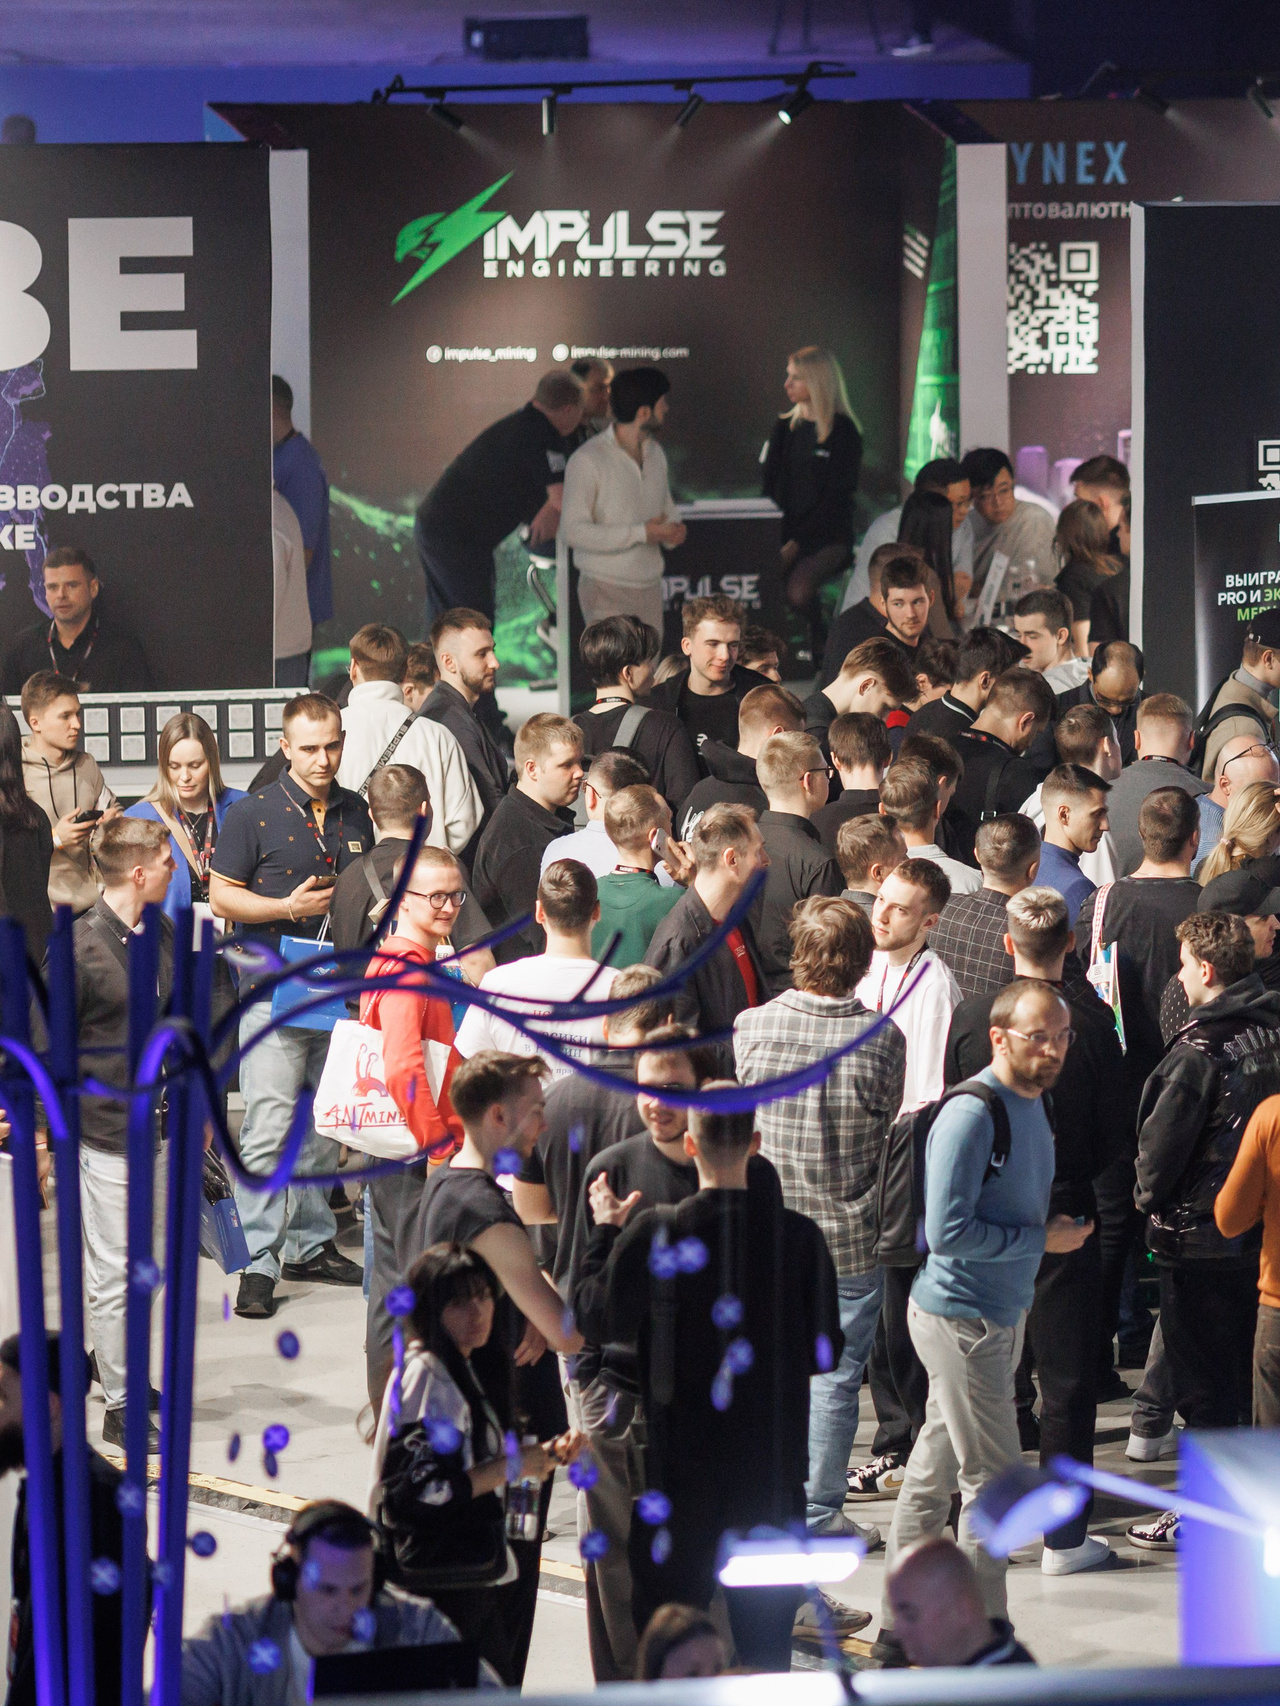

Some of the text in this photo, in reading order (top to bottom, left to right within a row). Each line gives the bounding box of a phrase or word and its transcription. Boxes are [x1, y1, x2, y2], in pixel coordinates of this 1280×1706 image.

[483, 210, 726, 260] IMPULSE
[483, 259, 727, 279] ENGINEERING
[444, 345, 537, 363] impulse_mining
[1218, 592, 1247, 606] PRO
[1250, 590, 1261, 603] И
